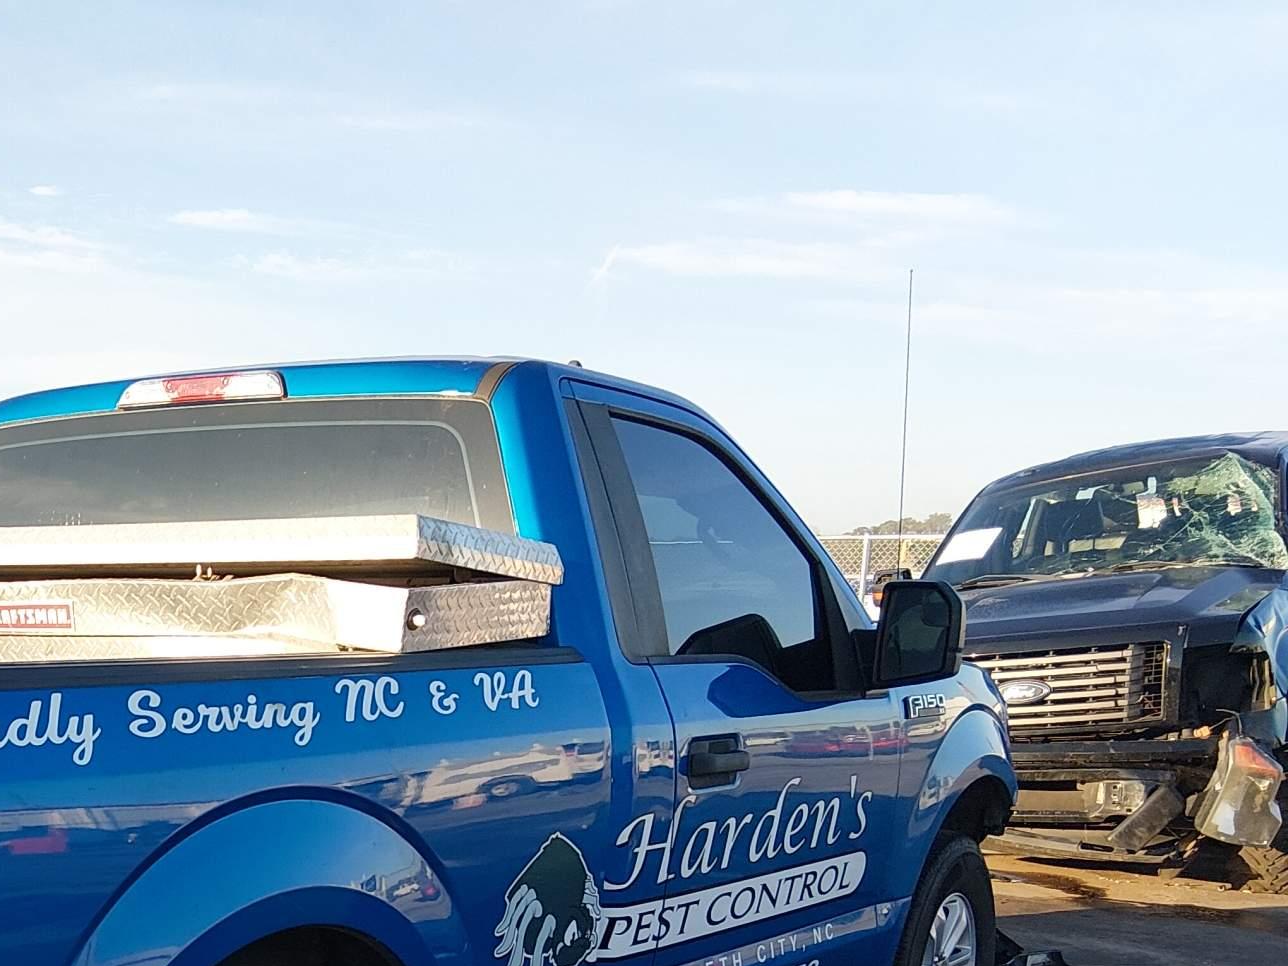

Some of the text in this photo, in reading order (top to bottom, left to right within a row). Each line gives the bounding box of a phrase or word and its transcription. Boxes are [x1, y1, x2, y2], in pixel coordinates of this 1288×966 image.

[129, 689, 320, 747] Serving
[334, 677, 404, 724] NC
[429, 680, 461, 715] &
[473, 670, 539, 710] VA
[603, 776, 873, 891] Harden's
[599, 861, 854, 951] PEST CONTROL
[756, 934, 807, 963] CITY,
[813, 923, 835, 946] NC
